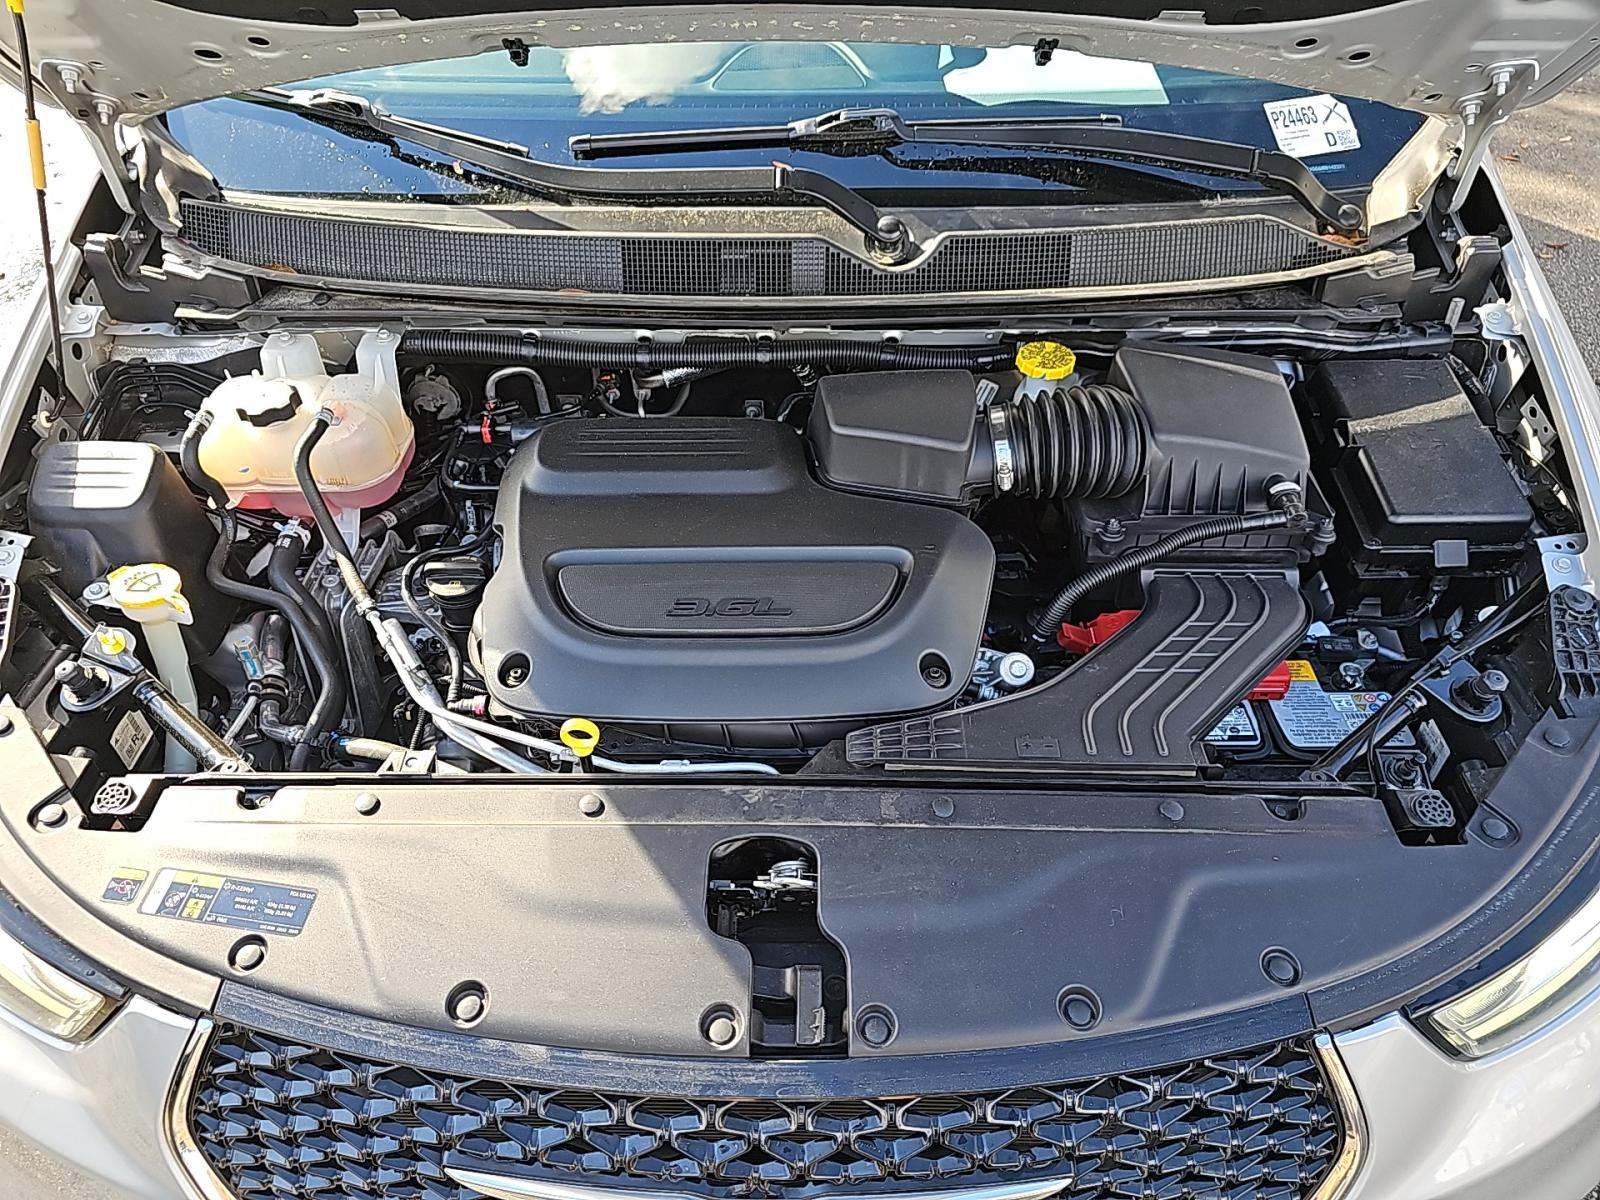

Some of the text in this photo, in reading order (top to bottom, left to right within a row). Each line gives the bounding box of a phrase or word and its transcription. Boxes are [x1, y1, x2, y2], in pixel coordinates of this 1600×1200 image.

[1270, 106, 1318, 129] P24463
[1325, 132, 1337, 147] D
[664, 598, 793, 617] 3.6L
